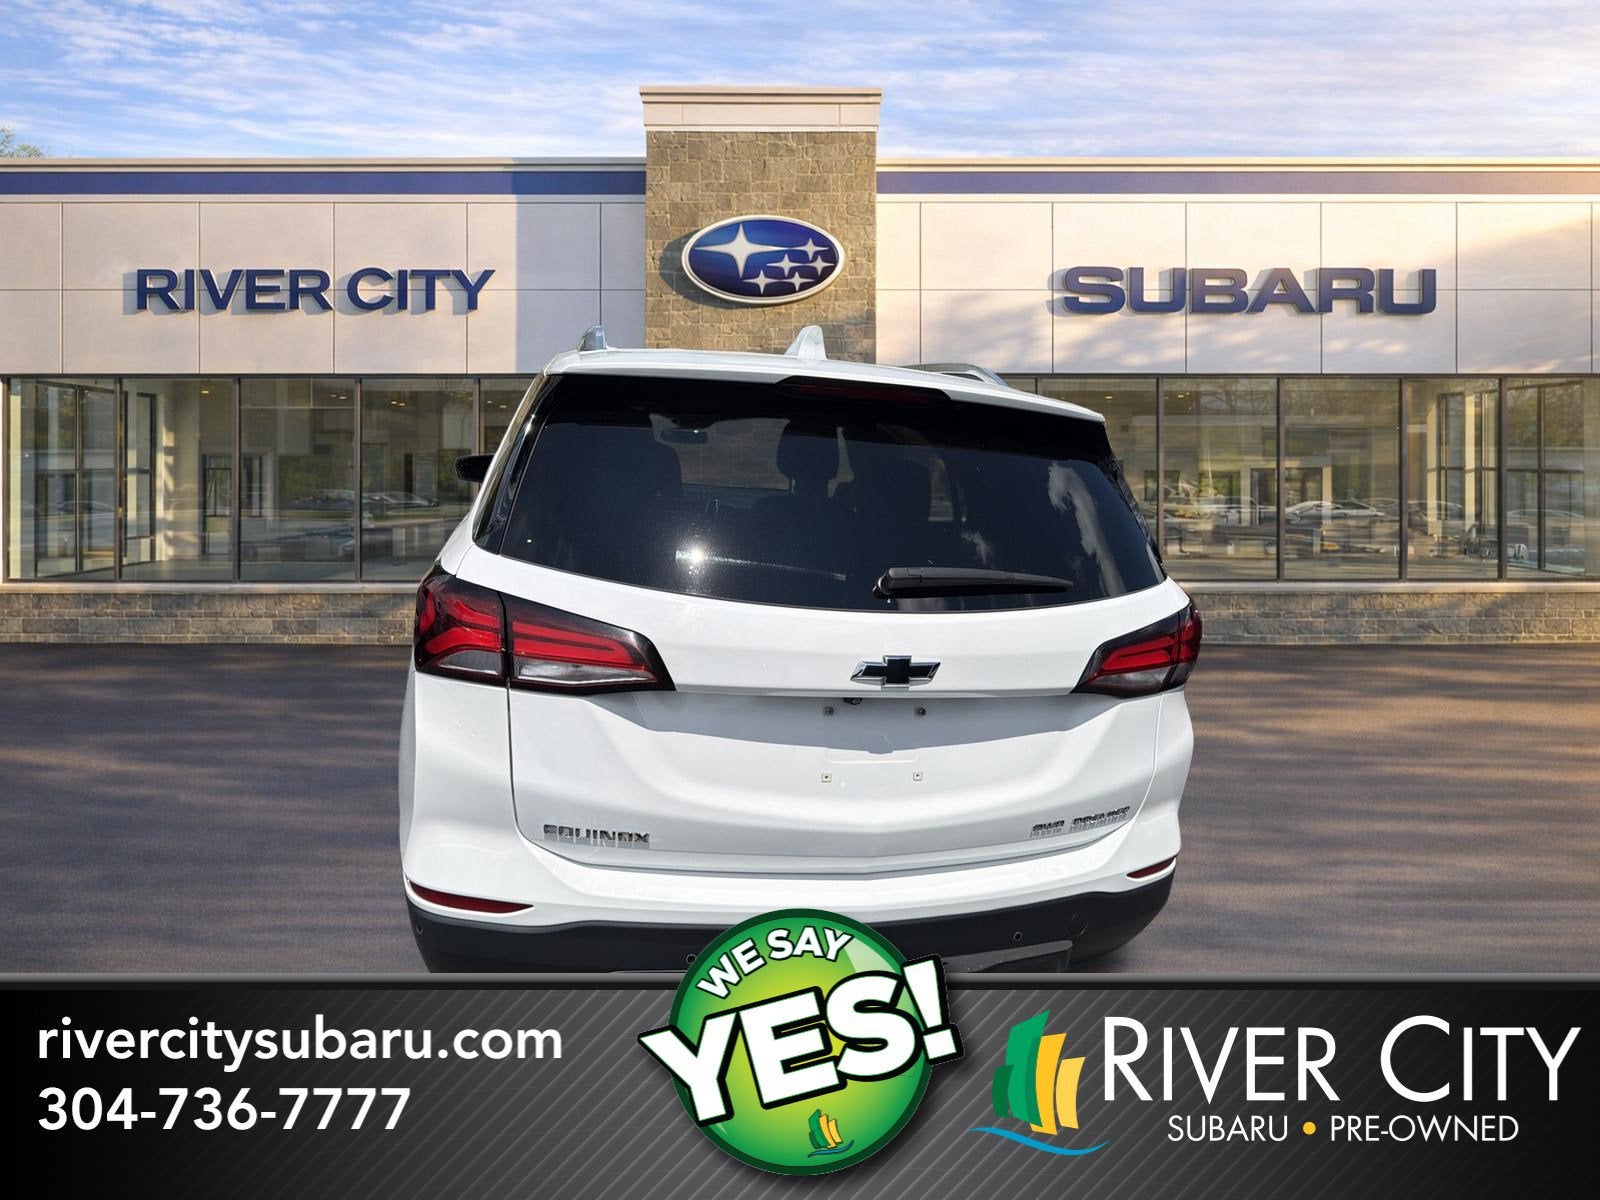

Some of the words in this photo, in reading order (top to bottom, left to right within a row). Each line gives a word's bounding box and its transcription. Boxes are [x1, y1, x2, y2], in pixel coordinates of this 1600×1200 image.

[136, 268, 335, 312] RIVER
[347, 267, 496, 311] CITY
[1063, 266, 1438, 315] SUBARU
